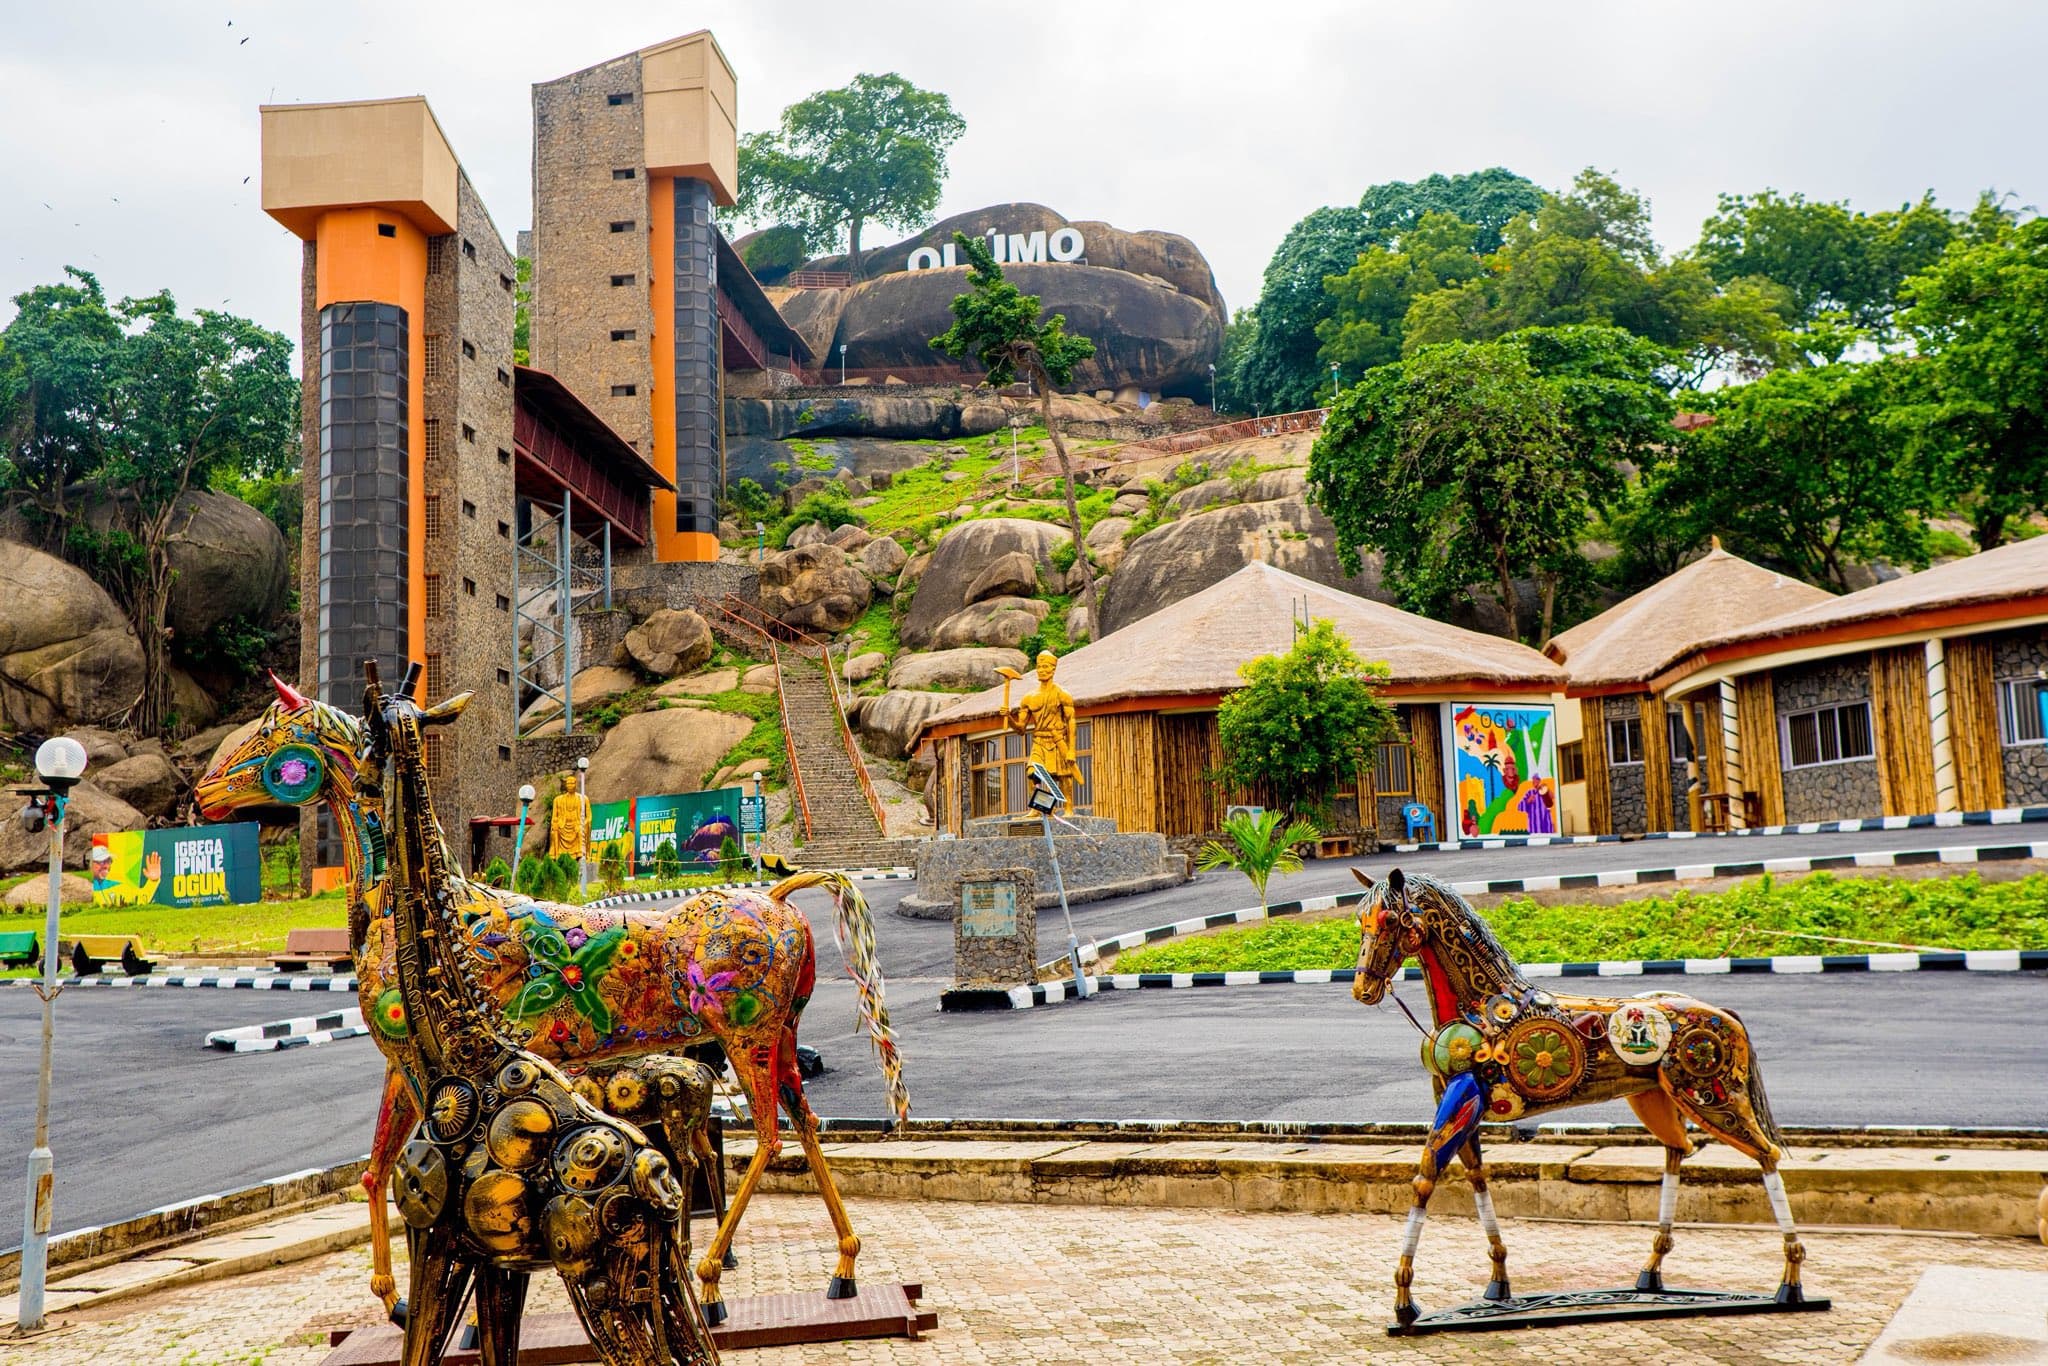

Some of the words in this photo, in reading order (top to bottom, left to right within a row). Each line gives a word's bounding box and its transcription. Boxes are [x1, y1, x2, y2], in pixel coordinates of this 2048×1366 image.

[1480, 711, 1530, 728] OGUN
[605, 816, 624, 840] WE
[174, 838, 224, 857] IGBEGA
[174, 854, 225, 875] IPINLE
[173, 872, 226, 898] OGUN
